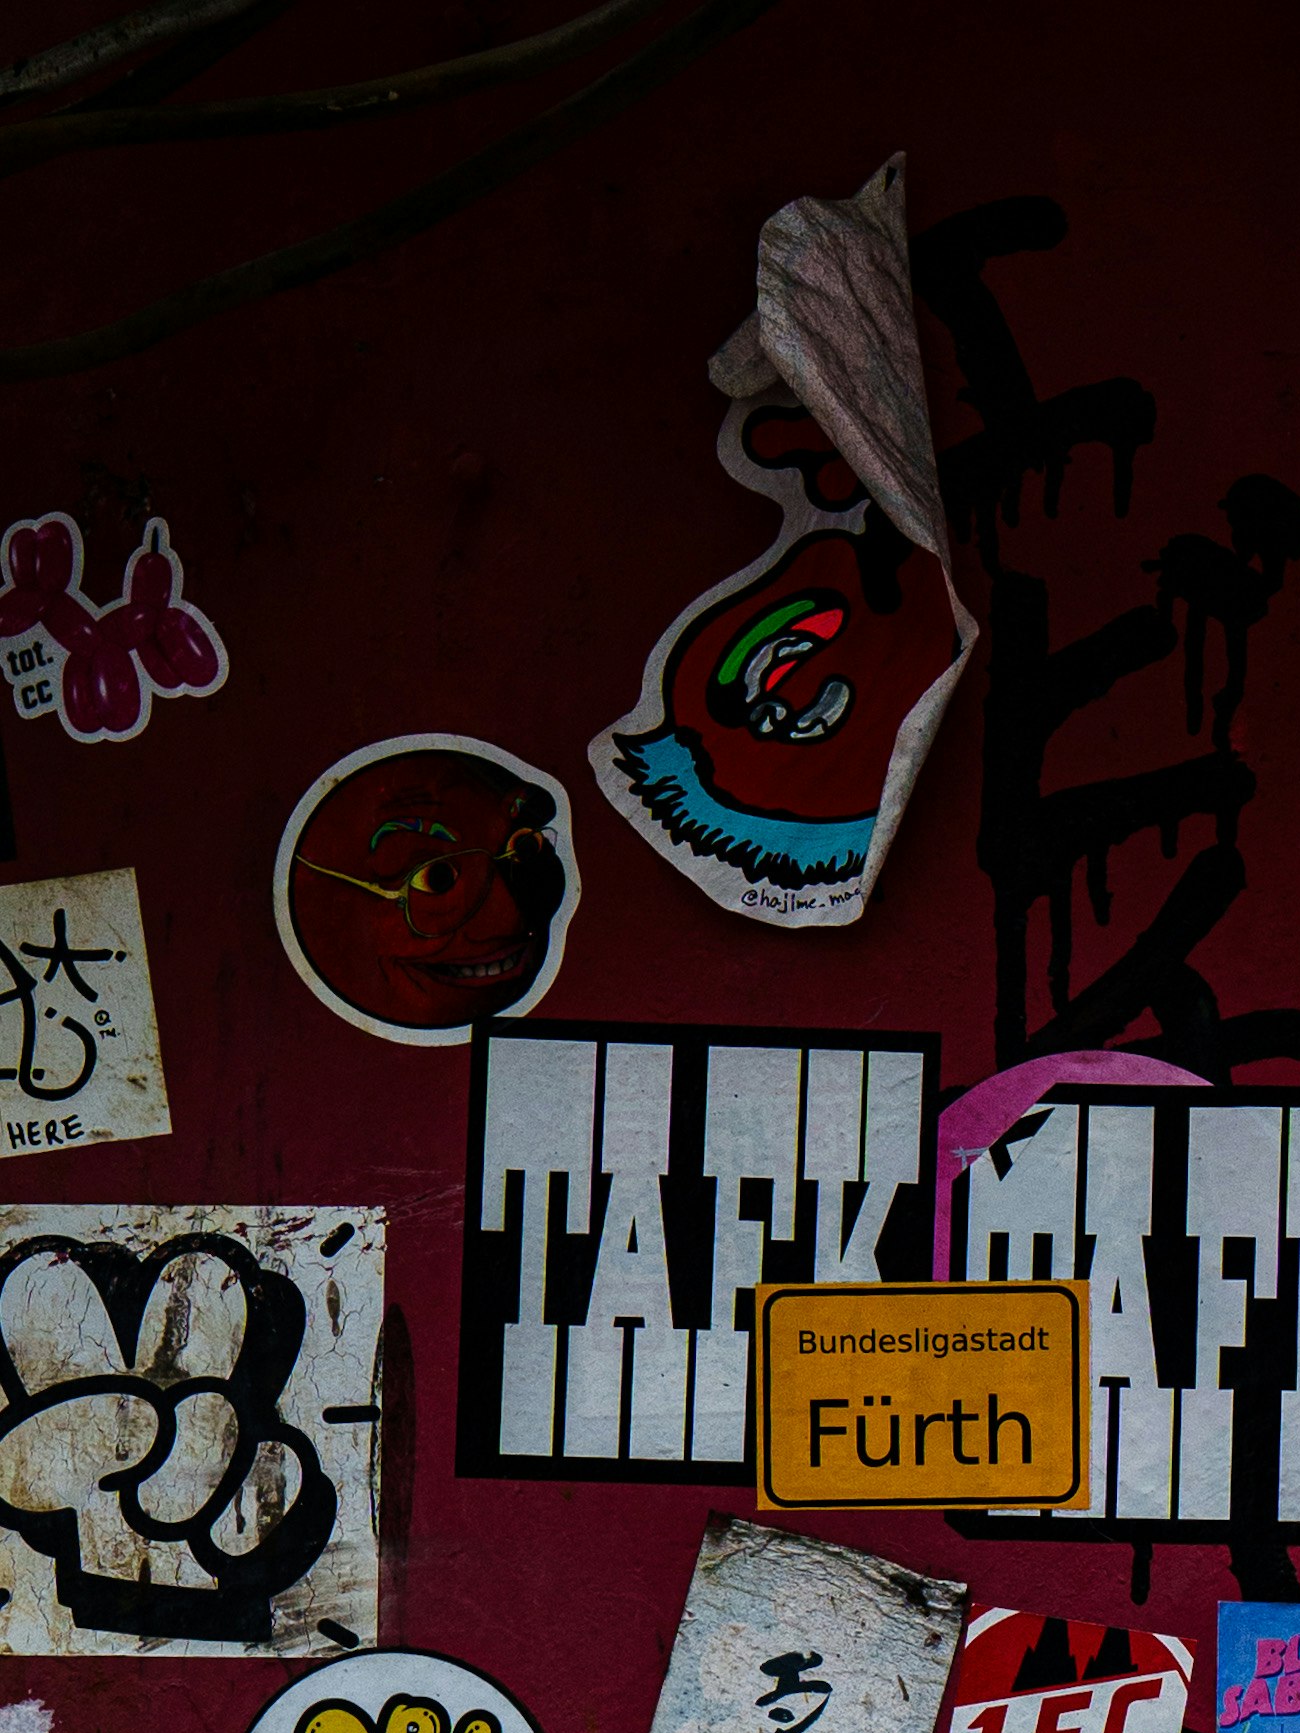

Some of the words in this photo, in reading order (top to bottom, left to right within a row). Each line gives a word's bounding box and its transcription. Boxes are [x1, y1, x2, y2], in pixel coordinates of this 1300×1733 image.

[8, 1116, 85, 1148] HERE
[799, 1325, 1050, 1360] Bundesligastadt
[809, 1392, 1033, 1469] Fürth
